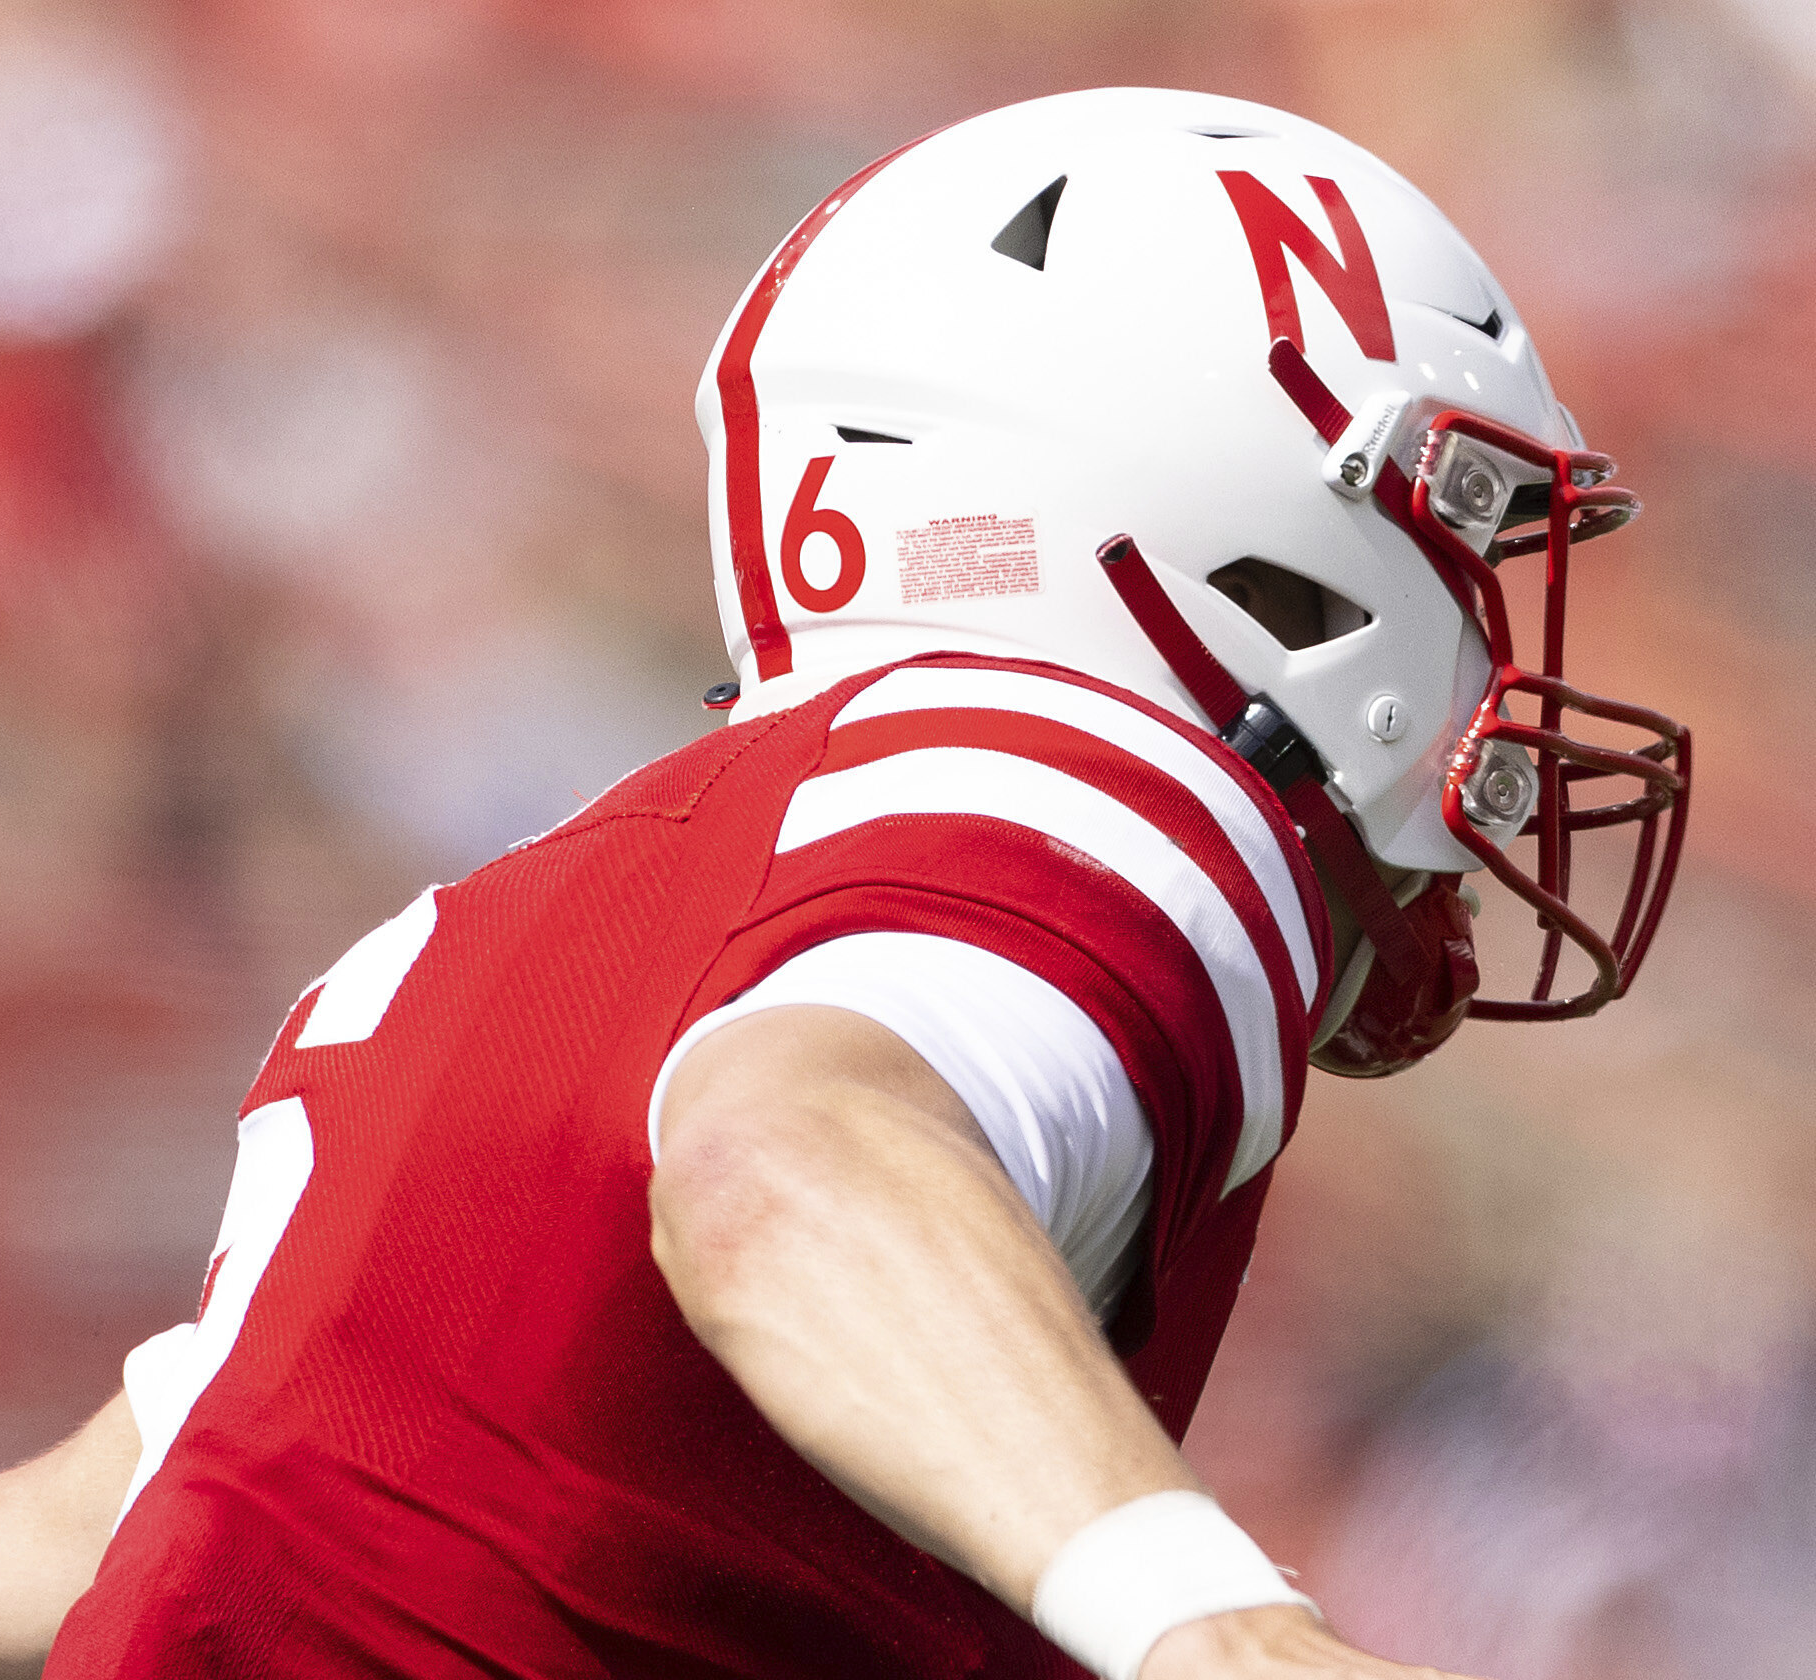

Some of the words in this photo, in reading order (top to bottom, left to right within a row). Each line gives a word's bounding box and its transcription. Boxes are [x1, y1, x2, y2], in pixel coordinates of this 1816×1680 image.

[1216, 170, 1398, 363] N
[780, 455, 867, 614] 6
[928, 513, 998, 526] WARNING
